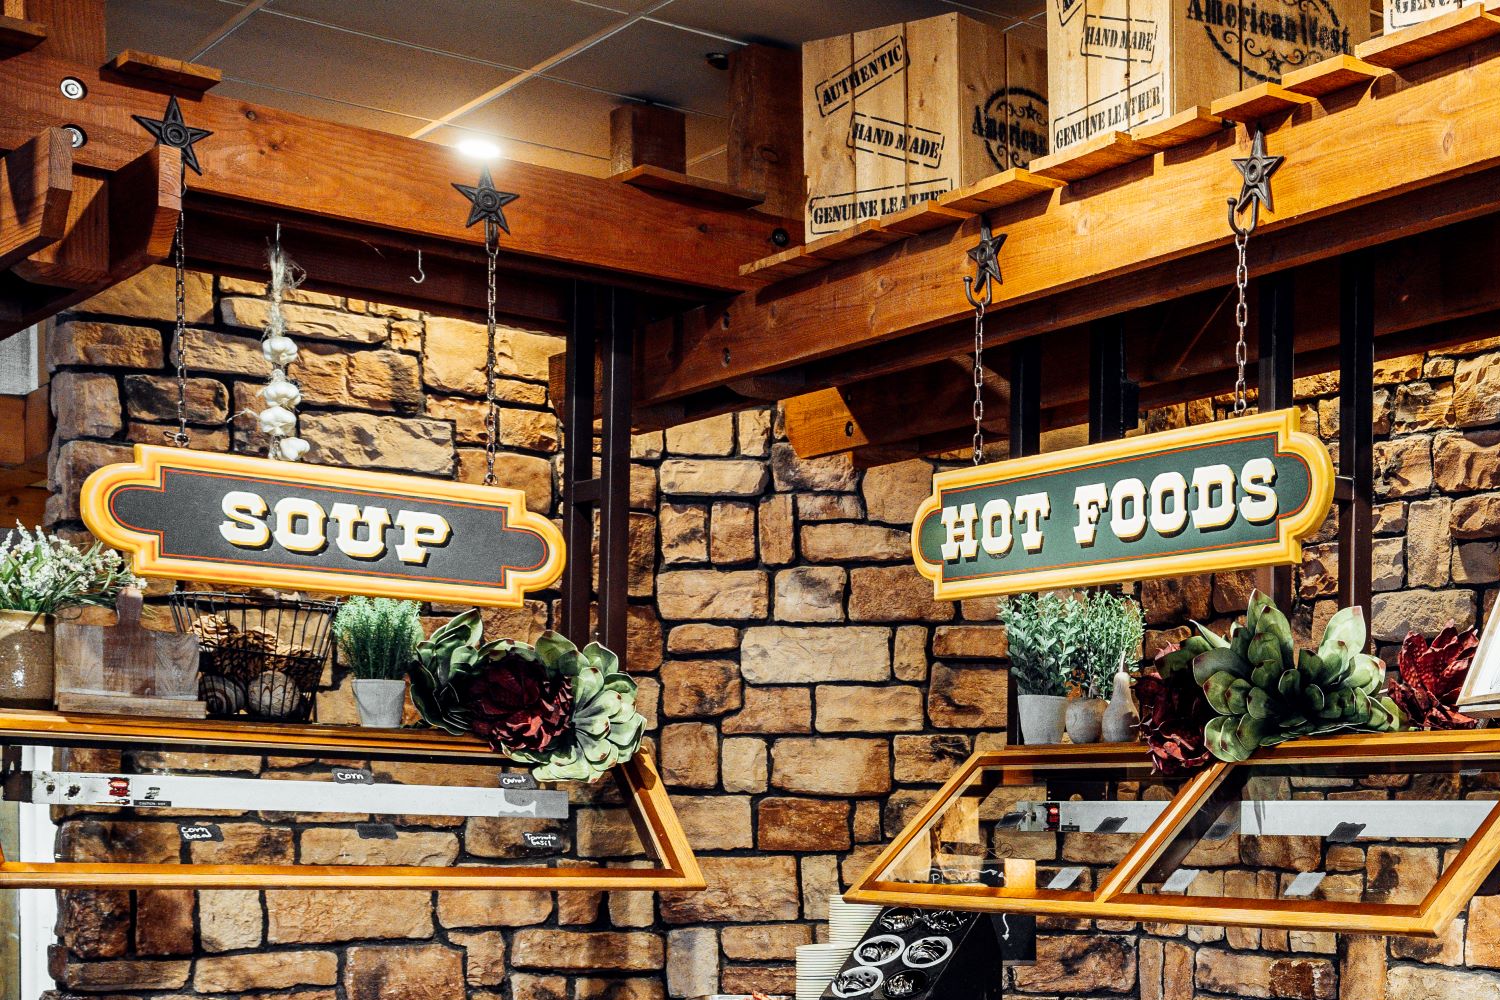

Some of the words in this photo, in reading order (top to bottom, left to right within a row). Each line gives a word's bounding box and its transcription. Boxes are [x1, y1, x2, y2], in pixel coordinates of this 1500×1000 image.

[1085, 26, 1118, 48] HAND
[1120, 30, 1154, 52] MADE
[822, 45, 903, 106] AUTHENTIC
[853, 123, 894, 148] HAND
[895, 133, 941, 159] MADE
[1056, 111, 1106, 149] GENUINE
[1108, 86, 1161, 127] LEATHER
[813, 199, 878, 225] GENUINE
[219, 490, 453, 567] SOUP
[940, 491, 1051, 562] HOT
[1072, 457, 1279, 546] FOODS
